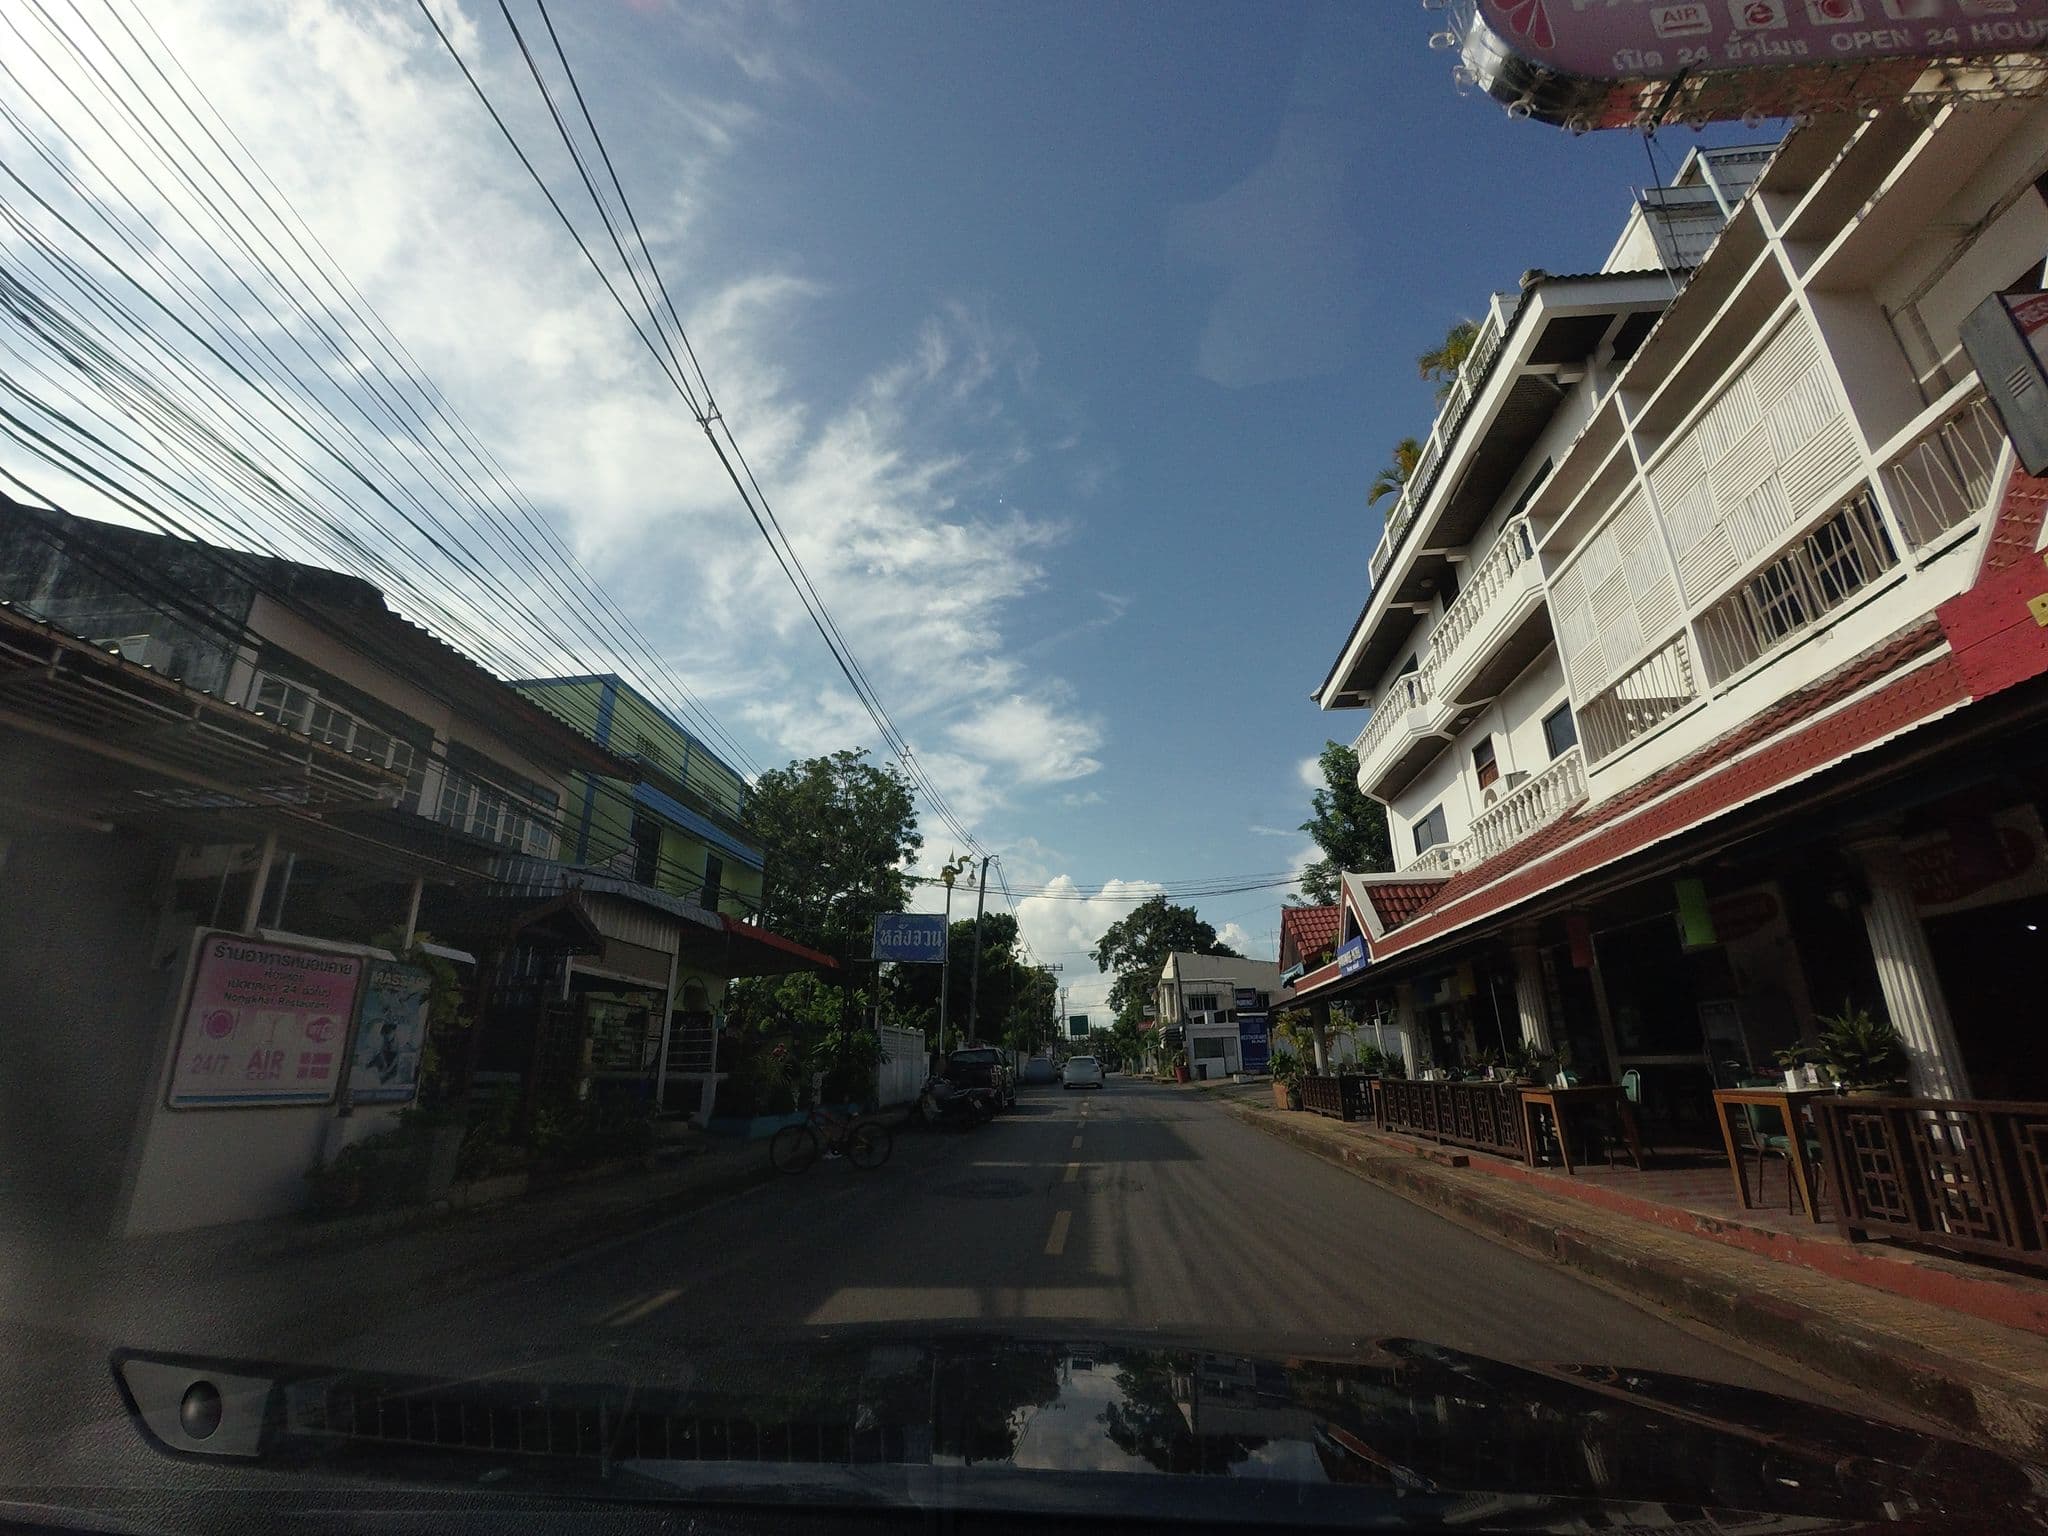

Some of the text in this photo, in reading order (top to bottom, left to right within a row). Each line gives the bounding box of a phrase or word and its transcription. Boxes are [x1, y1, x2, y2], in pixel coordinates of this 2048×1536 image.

[1663, 8, 1699, 24] AIR
[1612, 48, 1664, 71] เปิด
[1676, 46, 1712, 64] 24
[1721, 31, 1808, 59] ชั่วโมง
[1830, 28, 1912, 52] OPEN
[1926, 27, 1959, 46] 24
[246, 1048, 285, 1071] AIR
